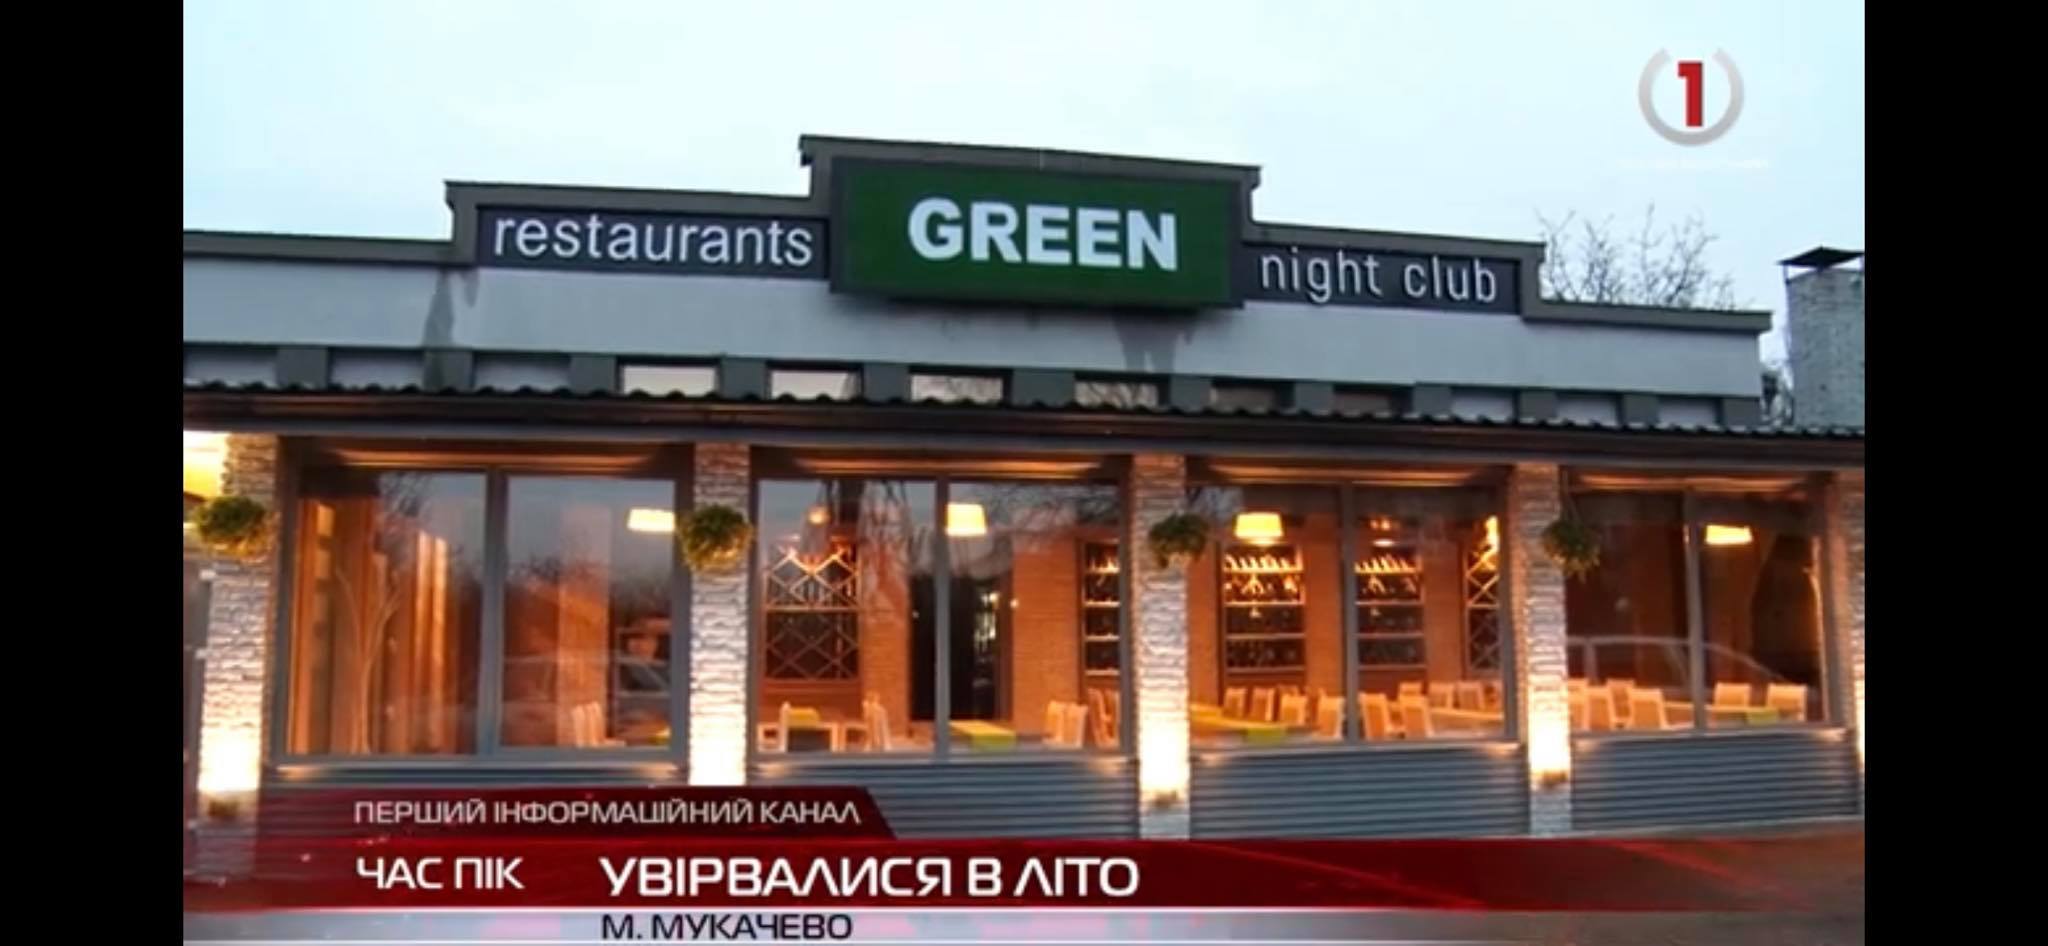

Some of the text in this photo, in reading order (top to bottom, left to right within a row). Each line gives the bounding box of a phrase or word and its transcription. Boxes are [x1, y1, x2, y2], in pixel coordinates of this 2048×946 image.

[494, 212, 814, 266] restaurants
[908, 198, 1178, 271] GREEN
[1260, 247, 1497, 302] night club
